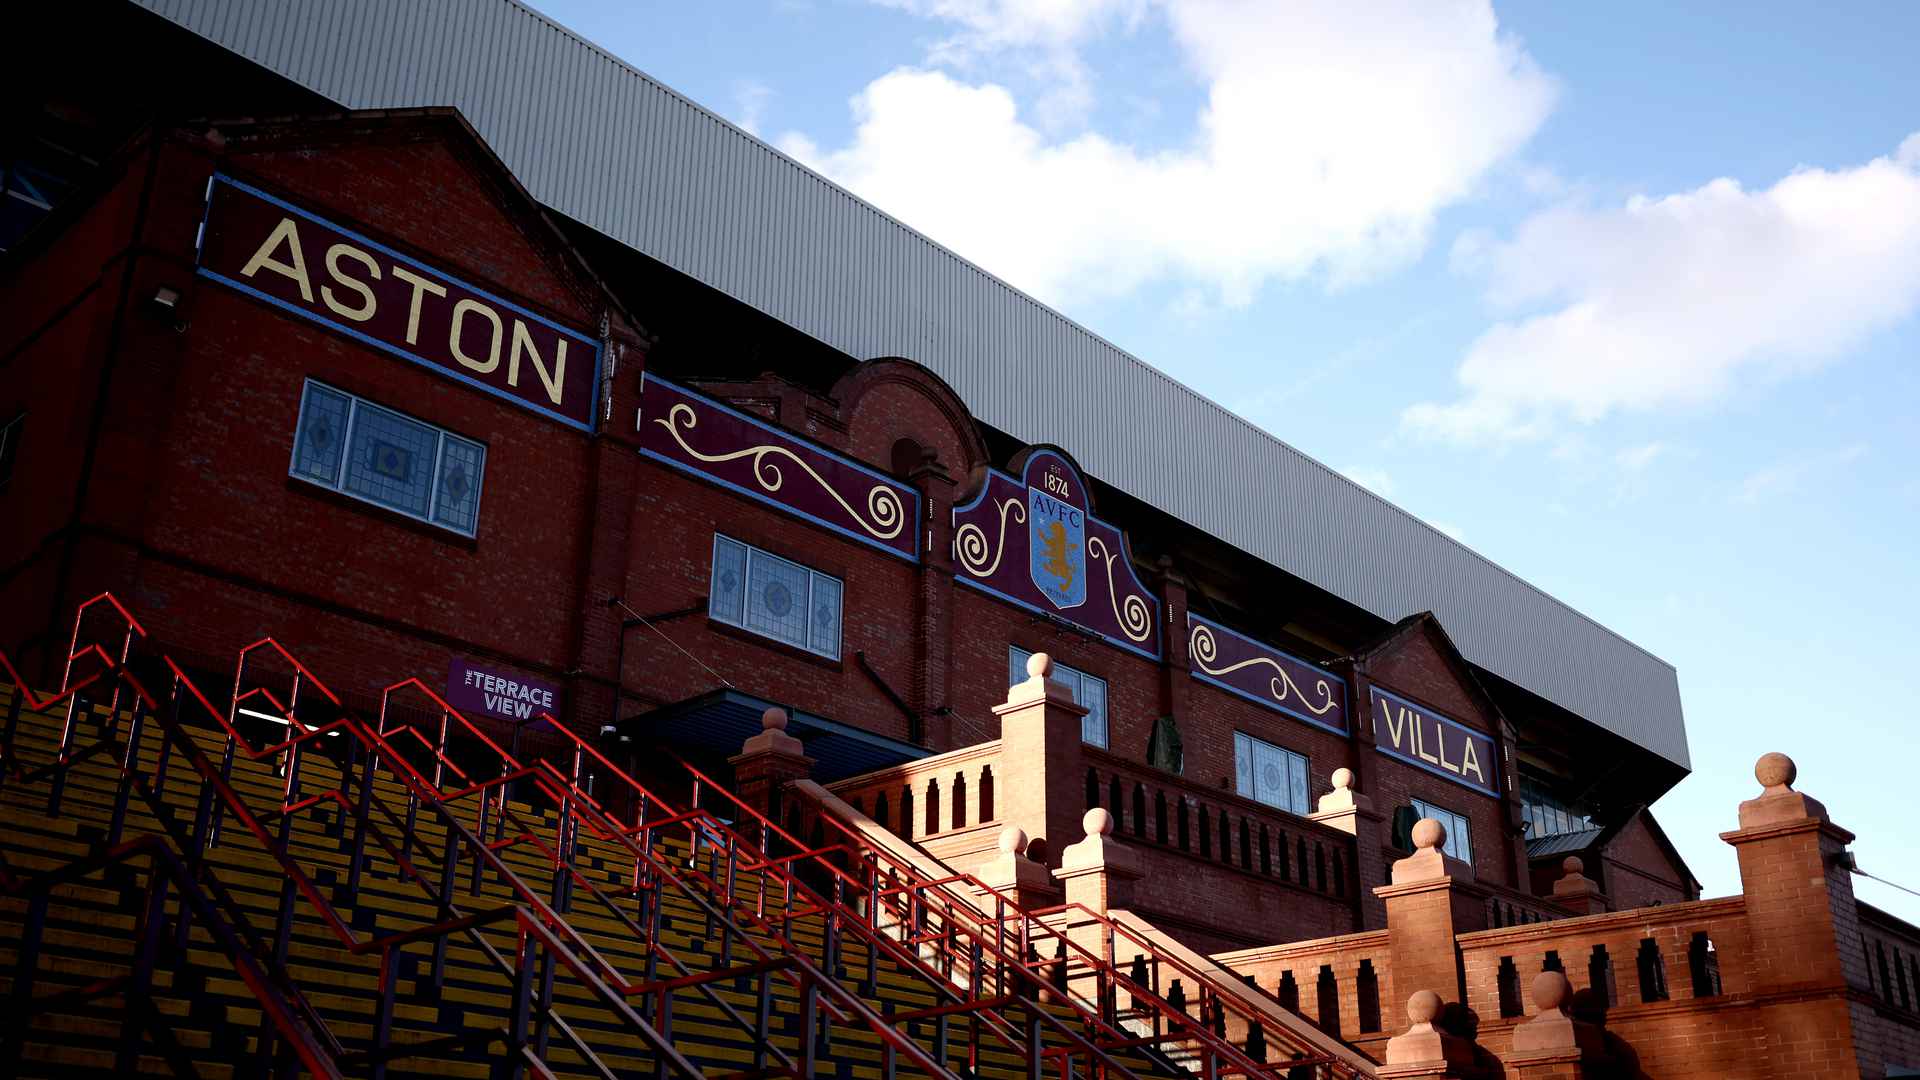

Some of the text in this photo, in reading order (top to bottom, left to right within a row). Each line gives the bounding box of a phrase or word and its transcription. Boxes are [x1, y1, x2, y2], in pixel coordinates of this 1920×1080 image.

[240, 217, 568, 405] ASTON
[1044, 472, 1069, 498] 1874
[1034, 495, 1079, 528] AVFC
[464, 669, 473, 685] THE
[474, 671, 552, 708] TERRACE
[484, 693, 533, 719] VIEW
[1381, 698, 1484, 784] VILLA
